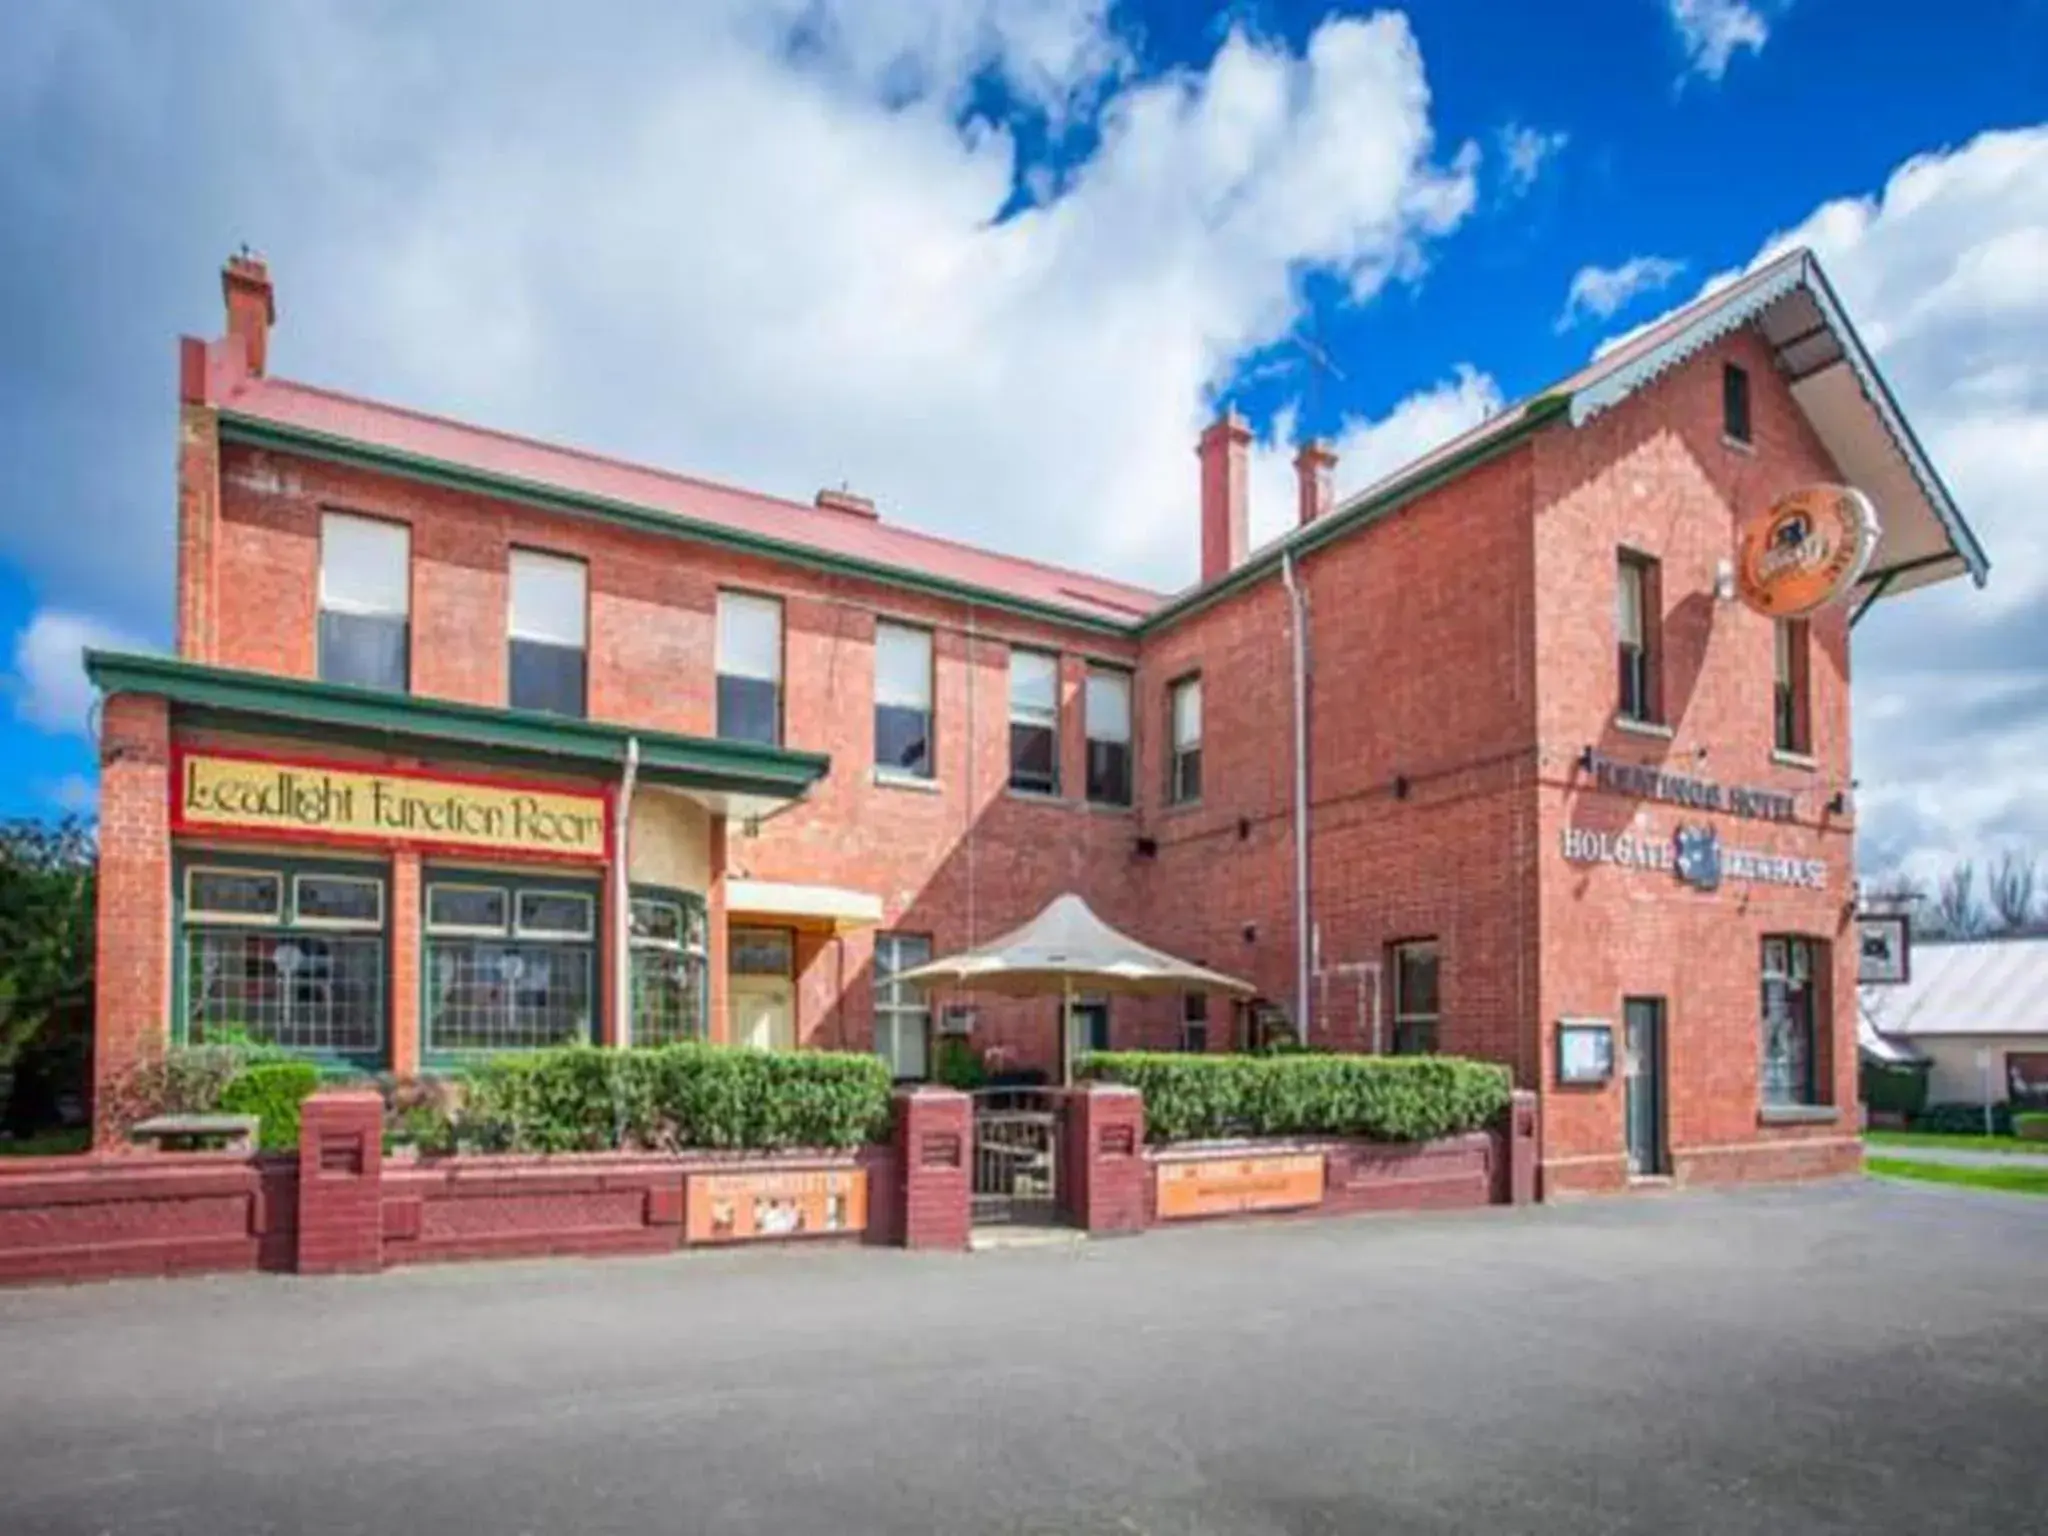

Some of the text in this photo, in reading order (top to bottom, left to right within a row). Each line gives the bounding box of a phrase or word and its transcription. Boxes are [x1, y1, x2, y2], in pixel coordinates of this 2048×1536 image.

[187, 761, 602, 844] Leadlight Function Room
[1563, 828, 1676, 870] HOLGATE
